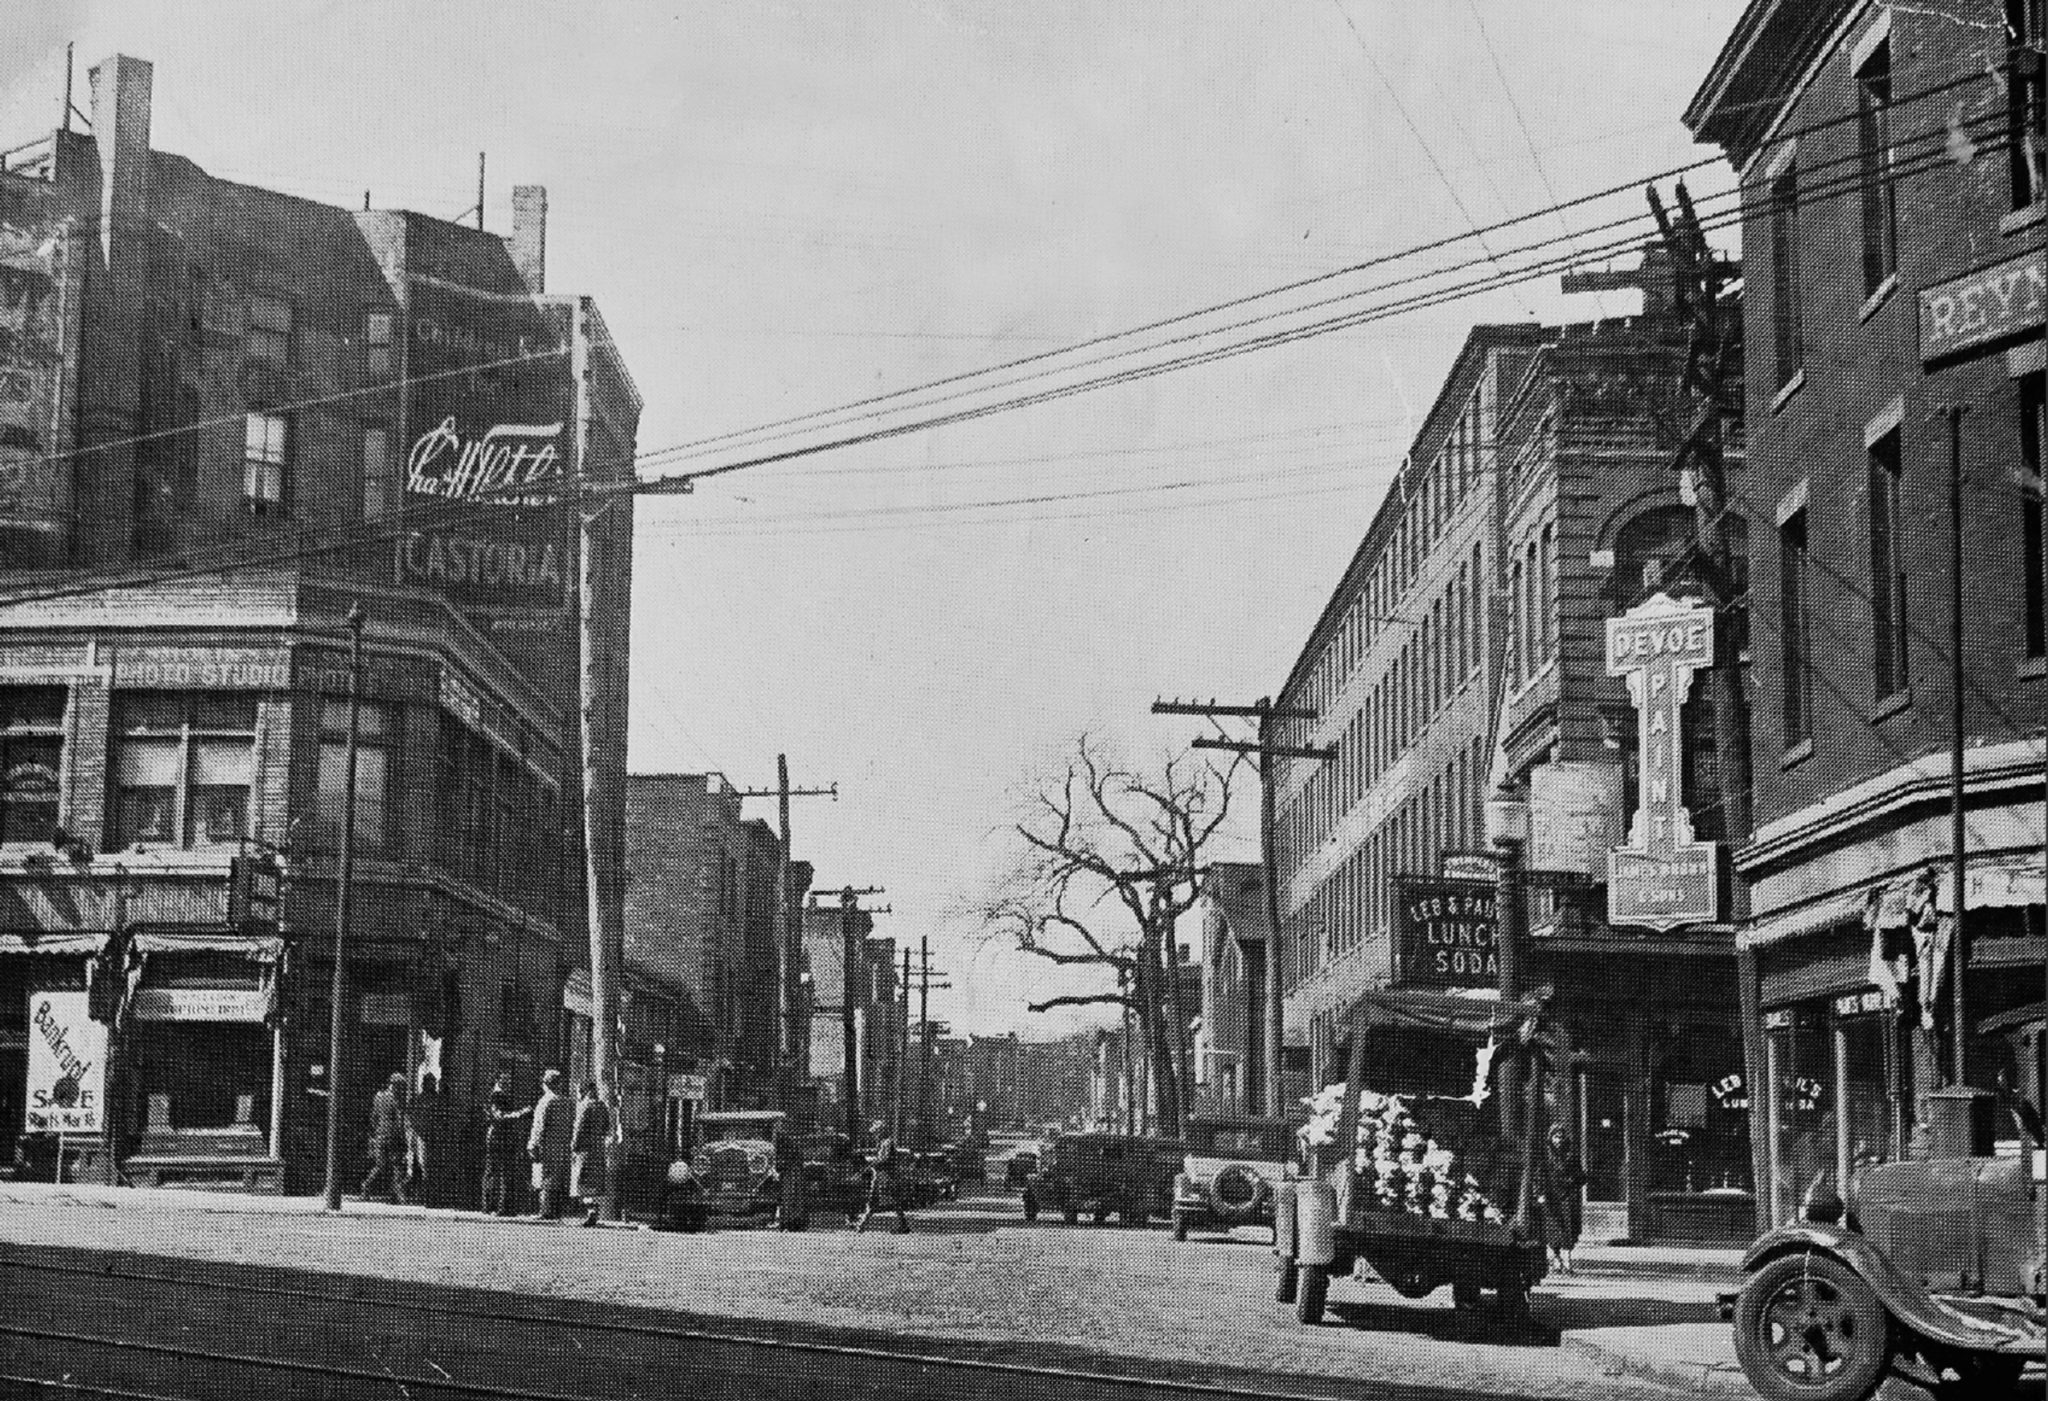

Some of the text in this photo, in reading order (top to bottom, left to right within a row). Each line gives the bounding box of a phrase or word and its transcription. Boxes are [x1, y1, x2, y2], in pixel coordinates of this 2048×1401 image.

[405, 534, 560, 586] CASTORIA
[1616, 624, 1702, 657] DEVOE
[115, 662, 290, 688] PHOTO STUDIO
[1650, 674, 1667, 839] PAINT
[1410, 895, 1500, 923] LEO & PAU
[1427, 921, 1500, 947] LUNCH
[1435, 949, 1498, 975] SODA
[32, 1089, 95, 1110] SE
